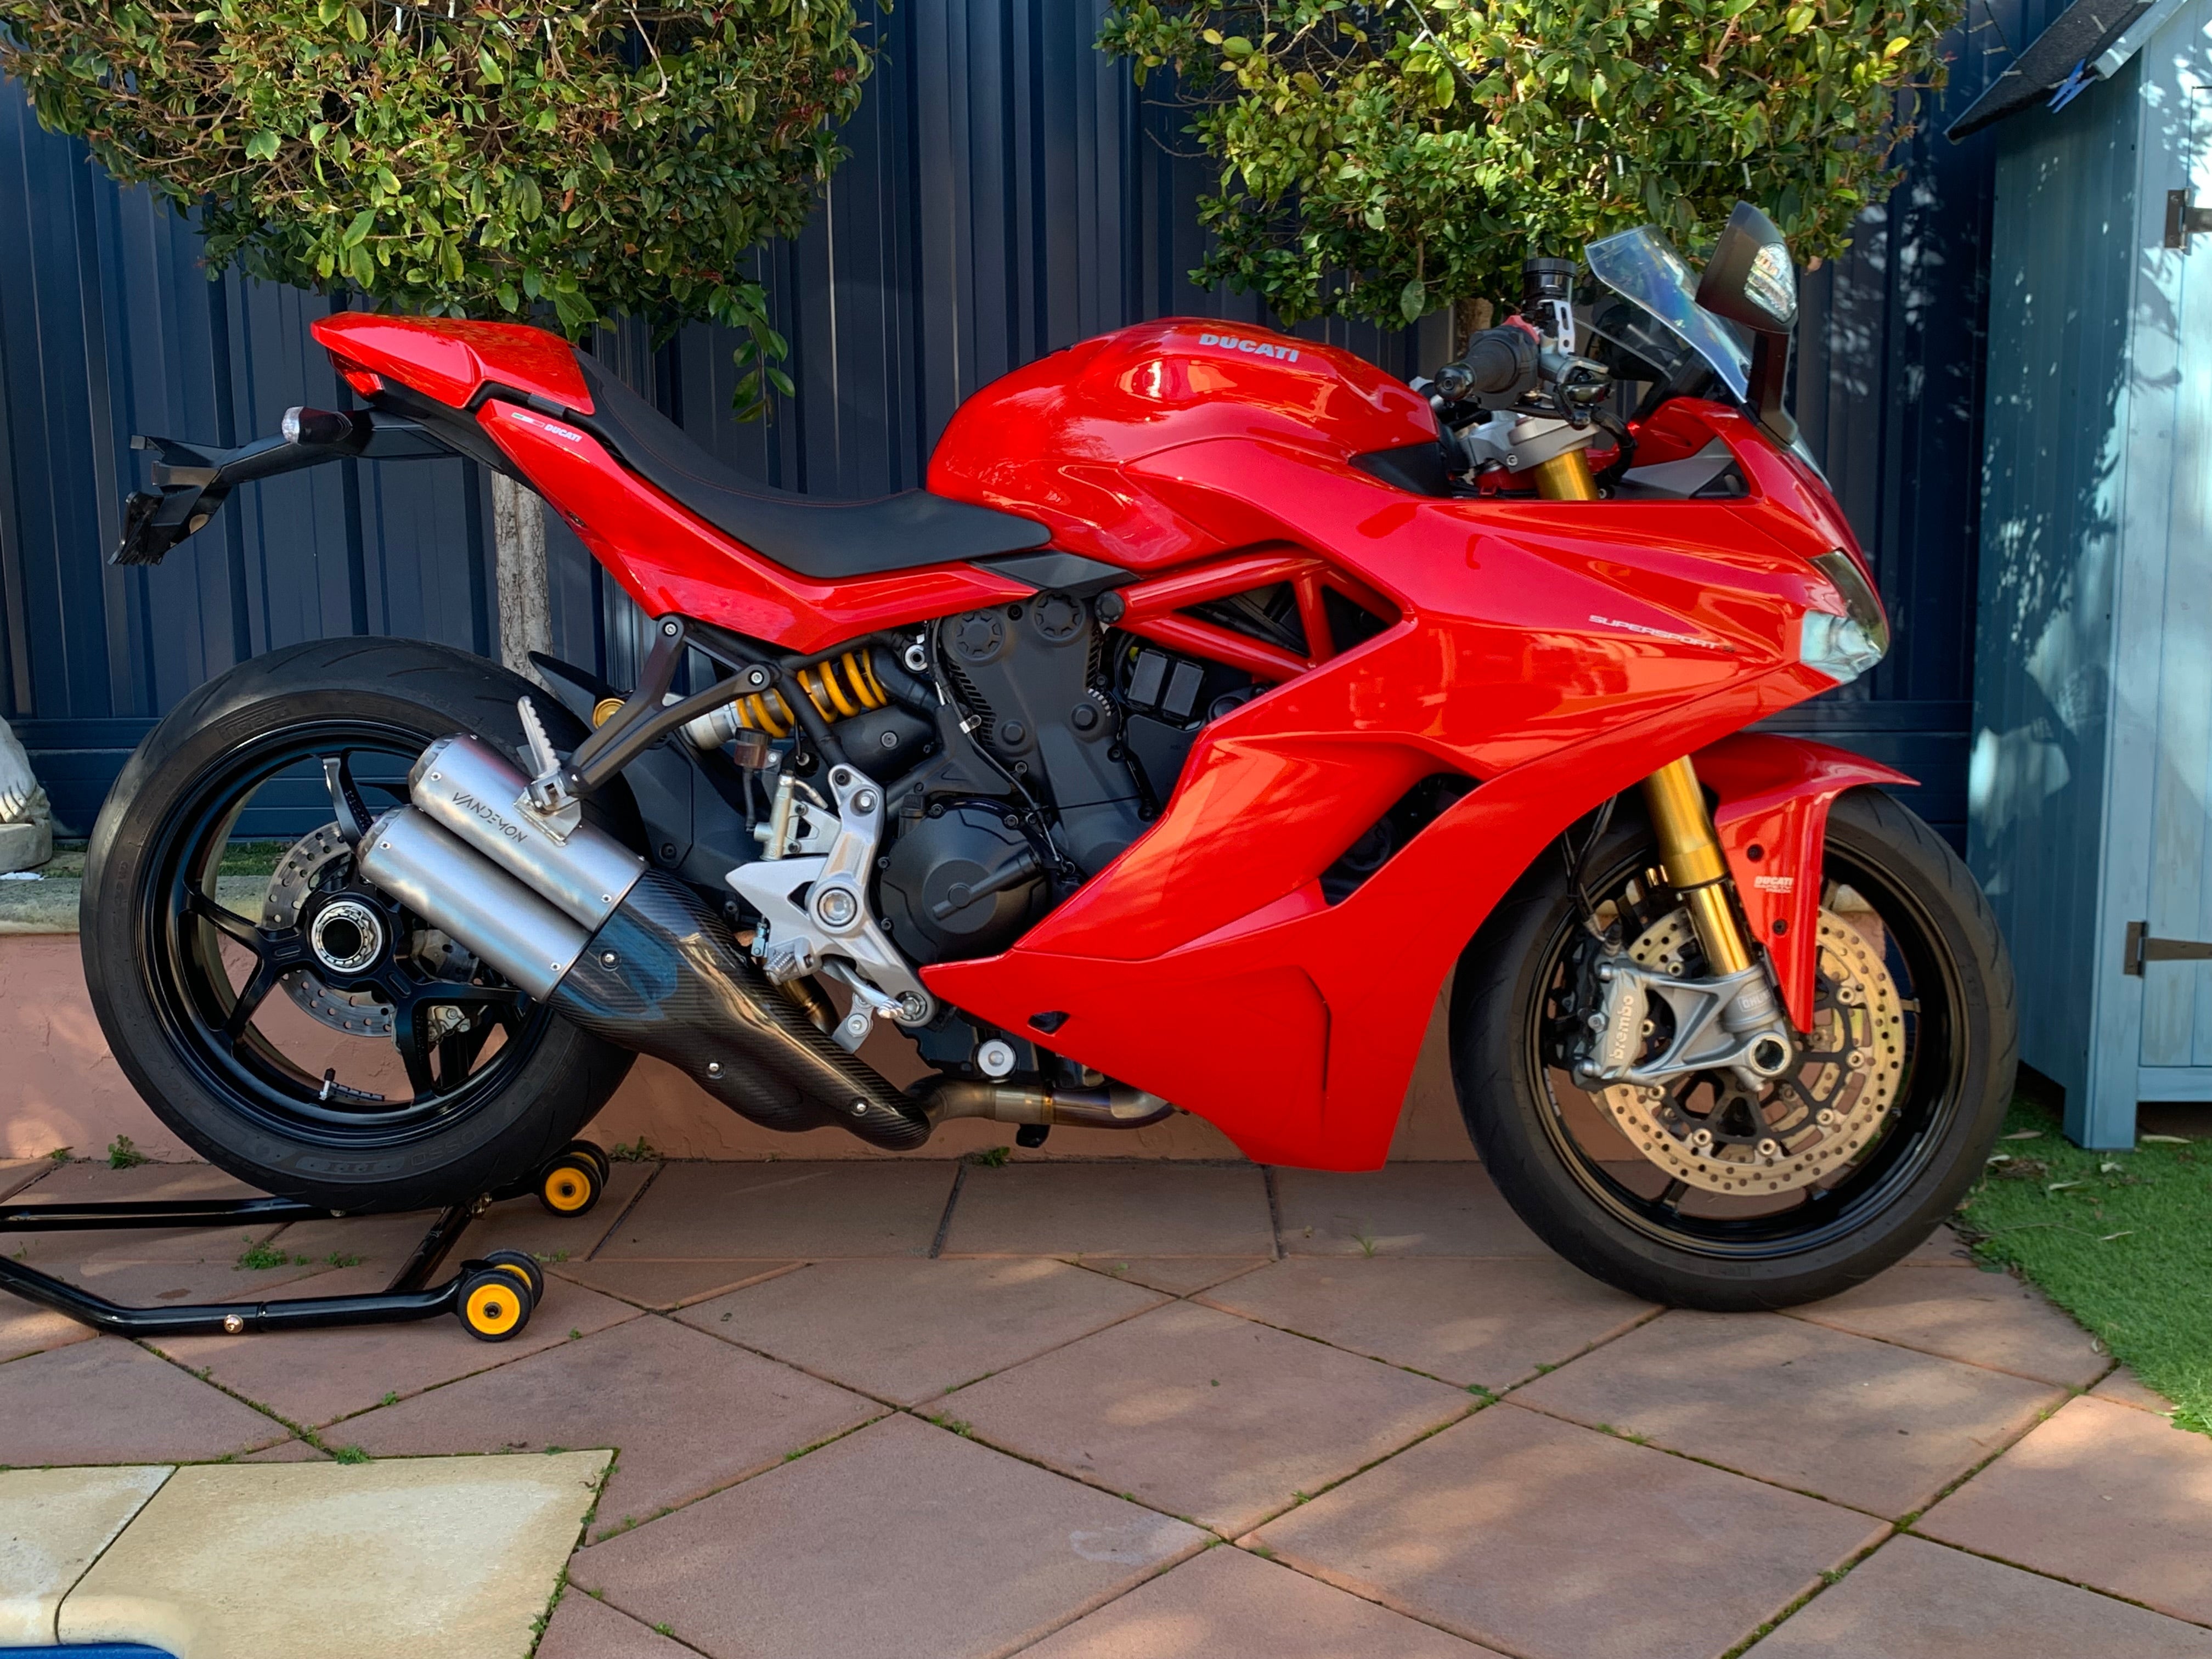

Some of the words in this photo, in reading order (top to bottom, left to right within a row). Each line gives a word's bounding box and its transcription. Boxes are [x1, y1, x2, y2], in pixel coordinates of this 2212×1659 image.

[1199, 333, 1300, 363] DUCATI
[544, 424, 583, 443] DUCATI
[1588, 614, 1719, 649] SUPERSPORT
[452, 792, 528, 843] VANDEMON
[1754, 876, 1793, 887] DUCATI
[1609, 995, 1634, 1060] brembo
